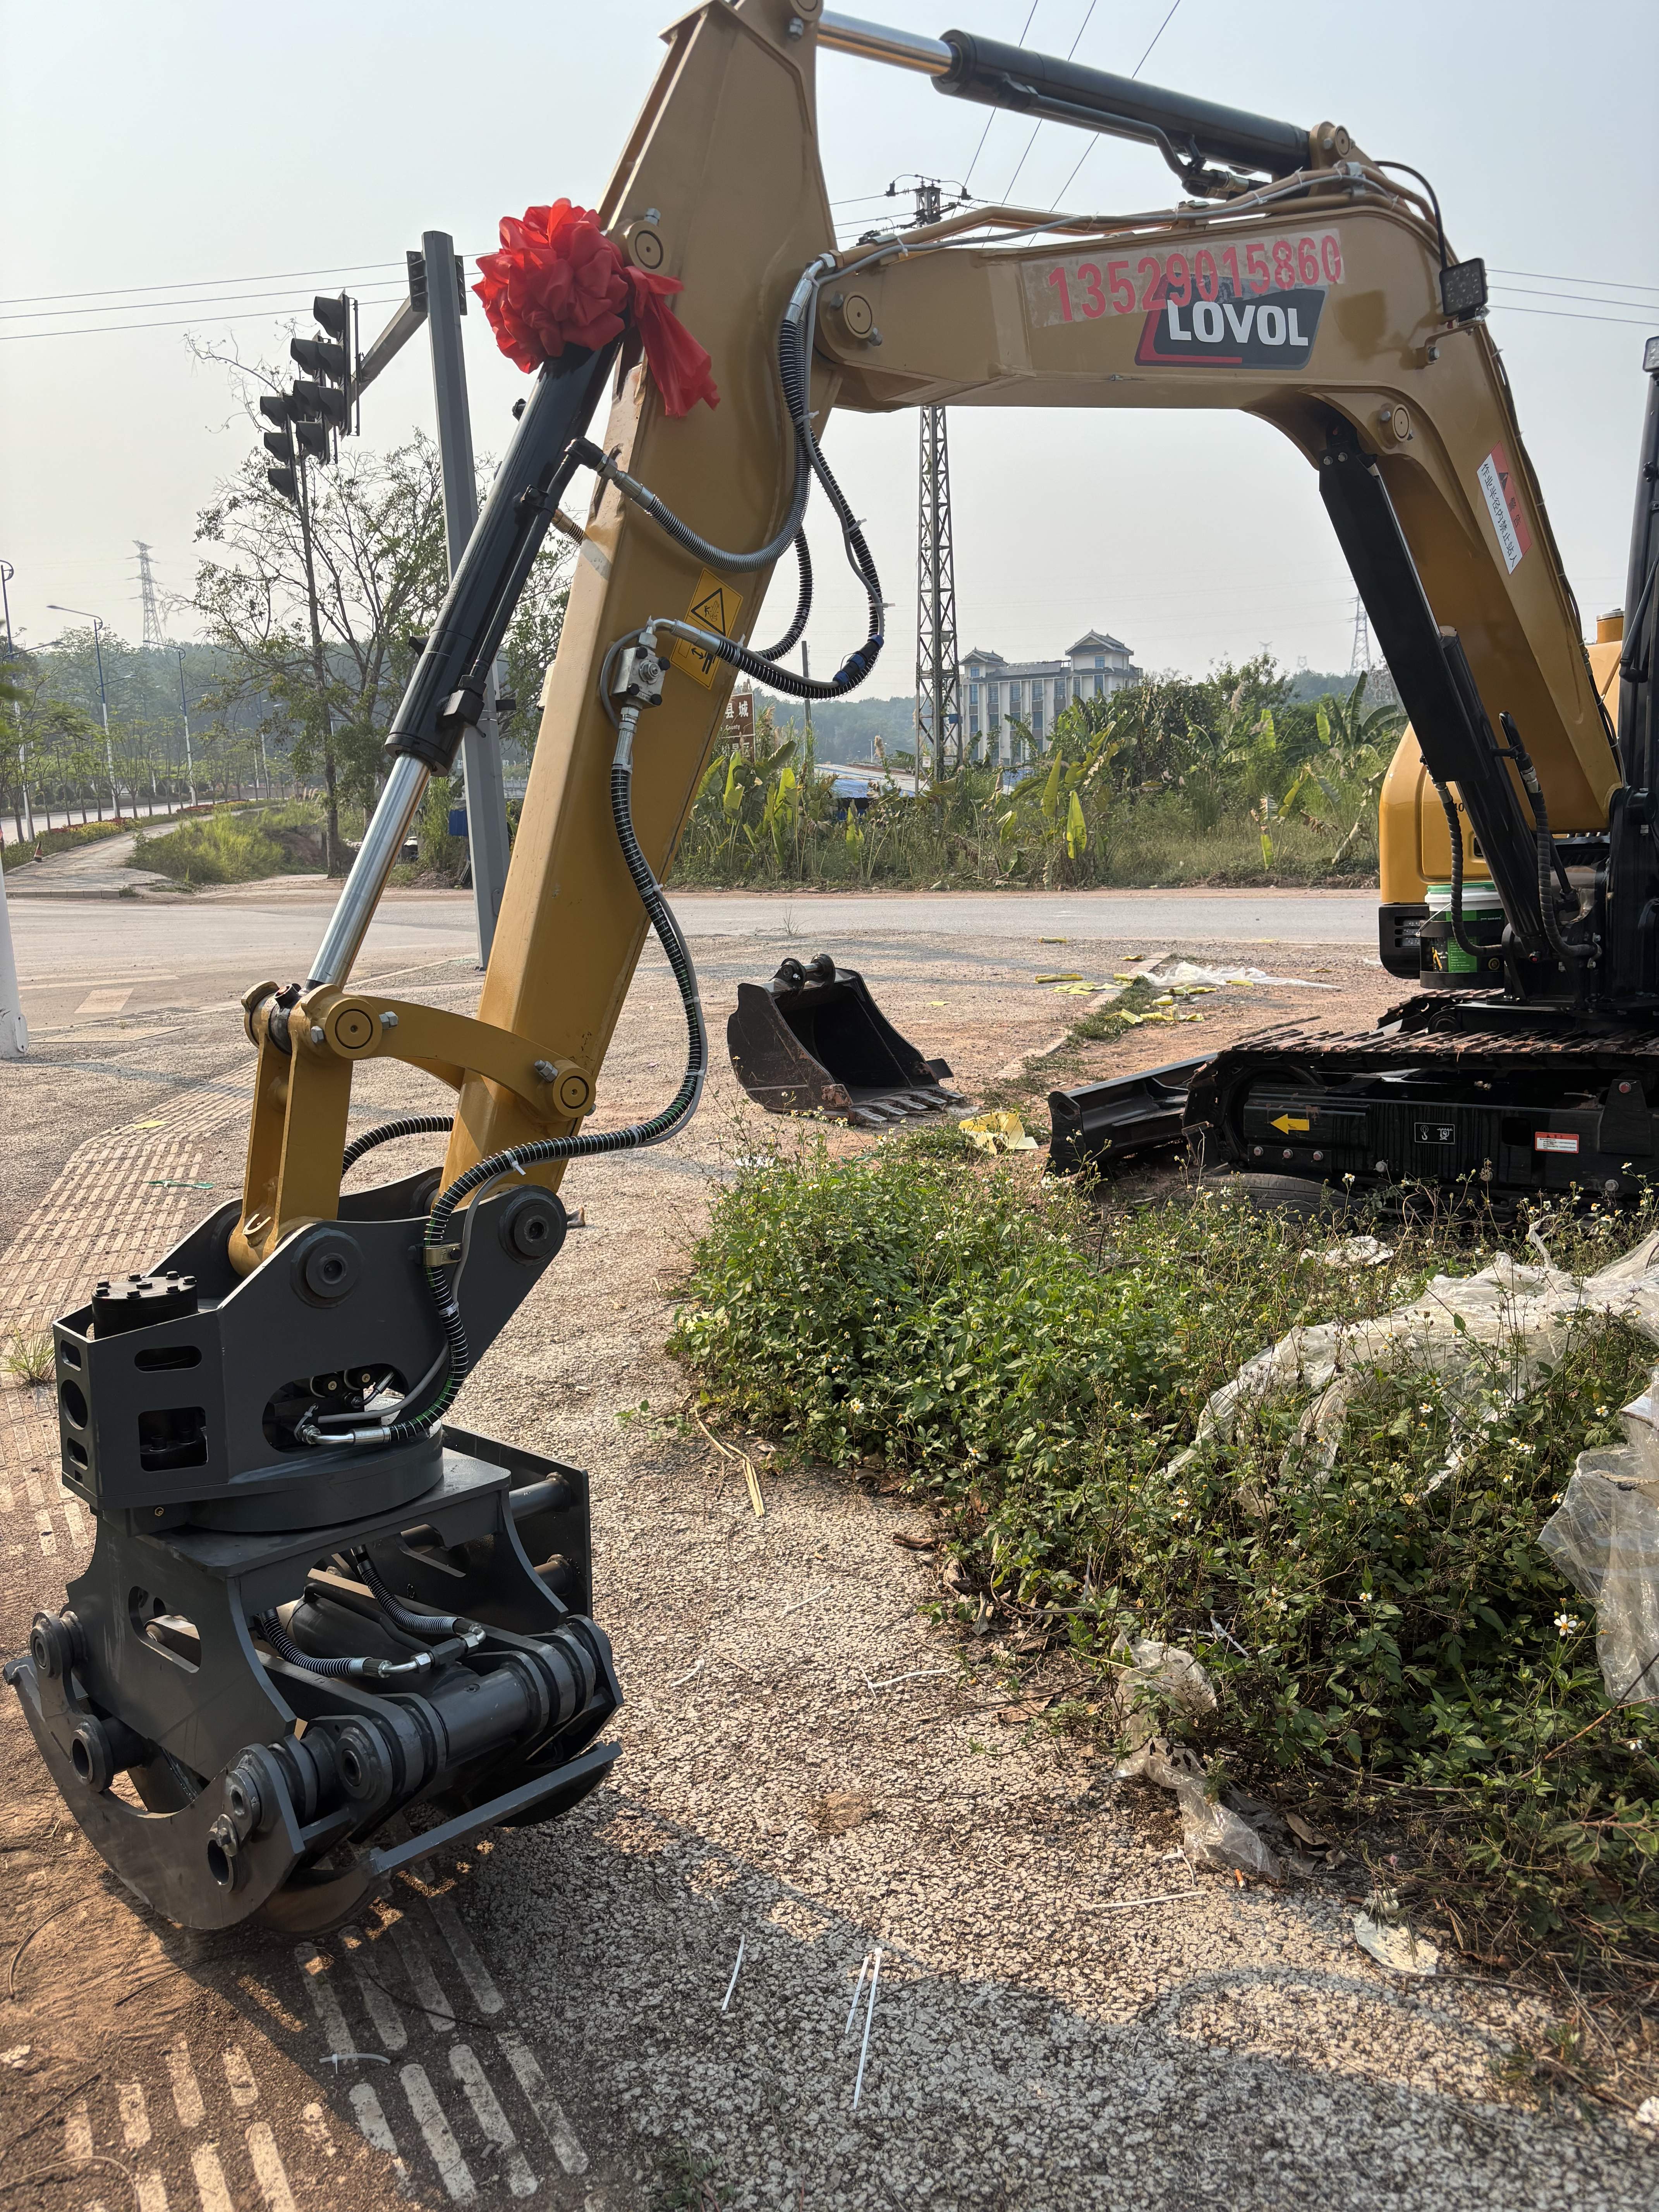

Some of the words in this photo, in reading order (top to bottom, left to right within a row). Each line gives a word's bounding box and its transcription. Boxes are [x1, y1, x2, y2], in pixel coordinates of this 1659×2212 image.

[1049, 235, 1341, 322] 13529015860
[1167, 300, 1309, 346] LOVOL
[1481, 464, 1517, 568] 作业半径内禁止站人
[725, 701, 749, 719] 县城
